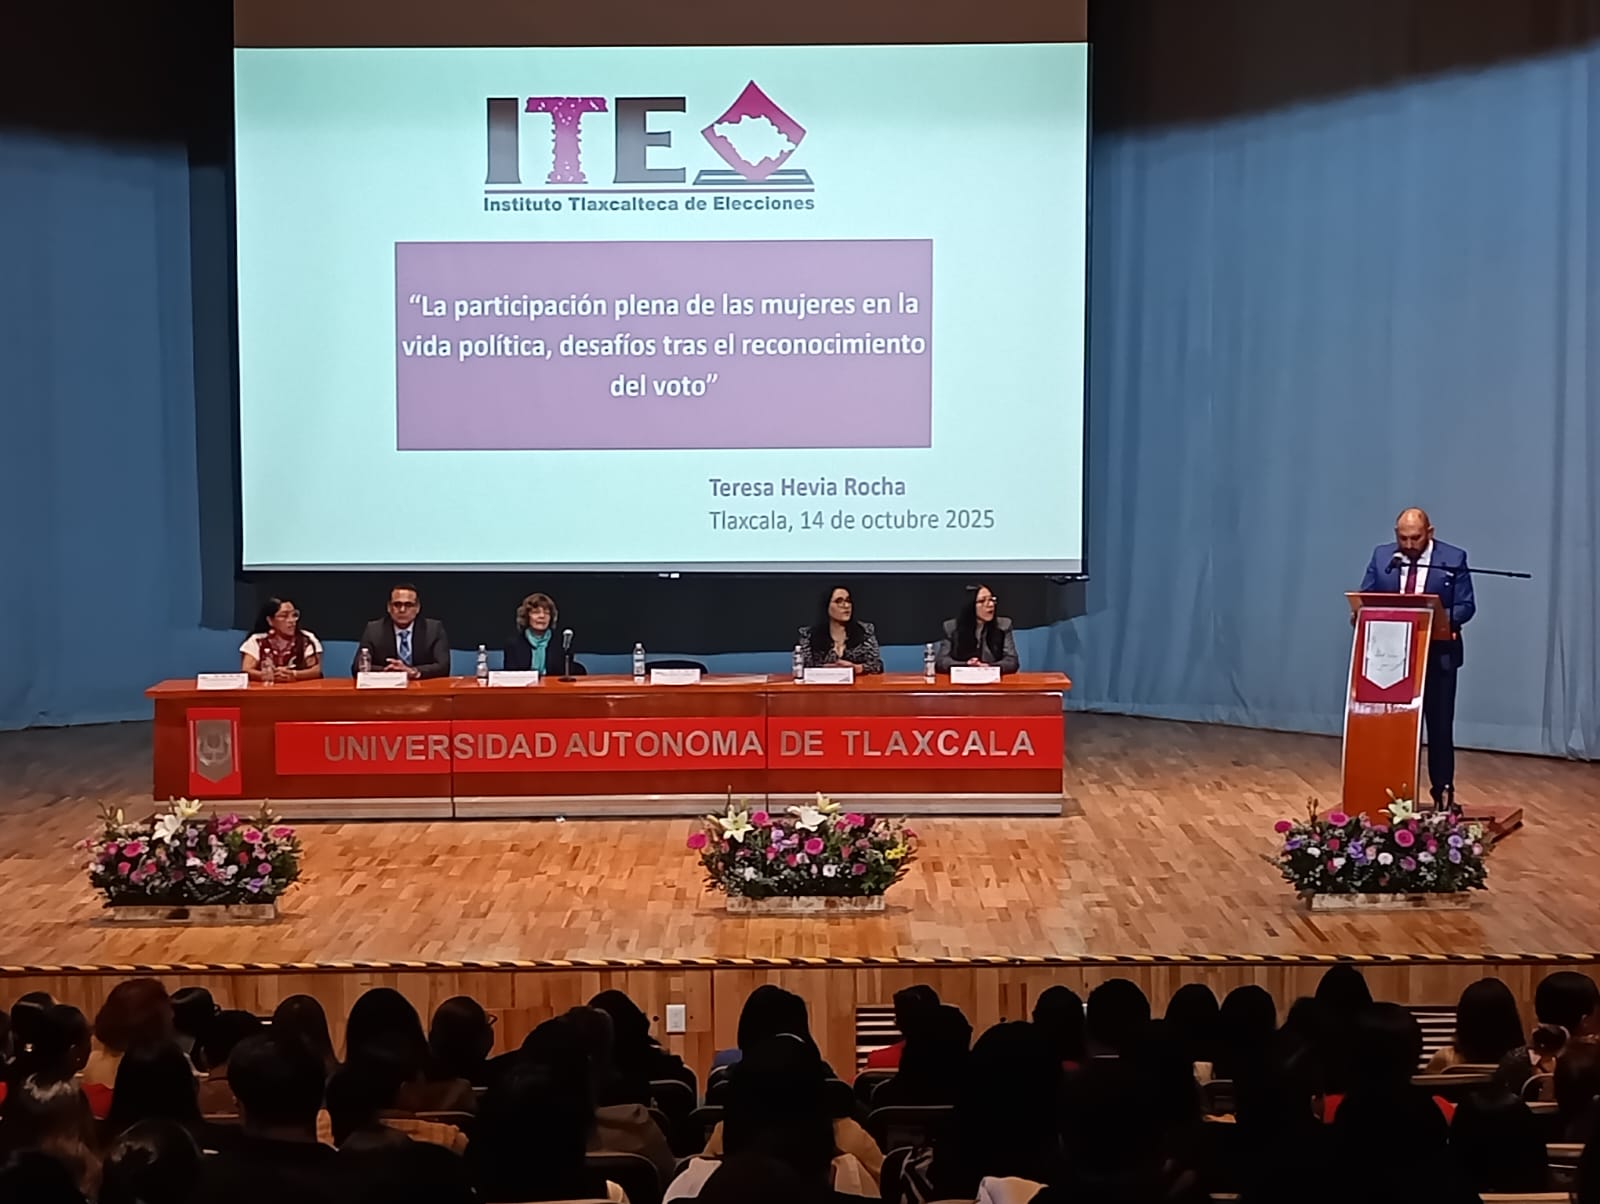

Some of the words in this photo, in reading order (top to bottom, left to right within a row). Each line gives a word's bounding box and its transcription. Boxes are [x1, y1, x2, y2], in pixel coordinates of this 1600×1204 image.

[485, 96, 687, 185] ITE
[484, 196, 562, 212] Instituto
[567, 196, 679, 212] Tlaxcalteca
[685, 196, 708, 211] de
[713, 195, 815, 211] Elecciones
[454, 293, 607, 322] participación
[615, 293, 679, 321] plena
[686, 293, 715, 315] de
[722, 293, 754, 315] las
[761, 293, 856, 320] mujeres
[862, 297, 891, 314] en
[898, 291, 918, 314] la
[402, 334, 451, 357] vida
[459, 333, 552, 361] política,
[559, 332, 656, 356] desafíos
[662, 335, 707, 356] tras
[714, 332, 734, 355] el
[742, 332, 926, 355] reconocimiento
[610, 374, 646, 397] del
[709, 478, 774, 497] Teresa
[781, 477, 837, 497] Hevia
[844, 476, 906, 496] Rocha
[709, 510, 793, 533] Tlaxcala,
[800, 510, 825, 530] 14
[830, 509, 855, 530] de
[861, 509, 939, 530] octubre
[945, 509, 995, 529] 2025
[324, 732, 557, 761] UNIVERSIDAD
[564, 730, 764, 758] AUTONOMA
[780, 730, 824, 756] DE
[841, 730, 1035, 756] TLAXCALA
